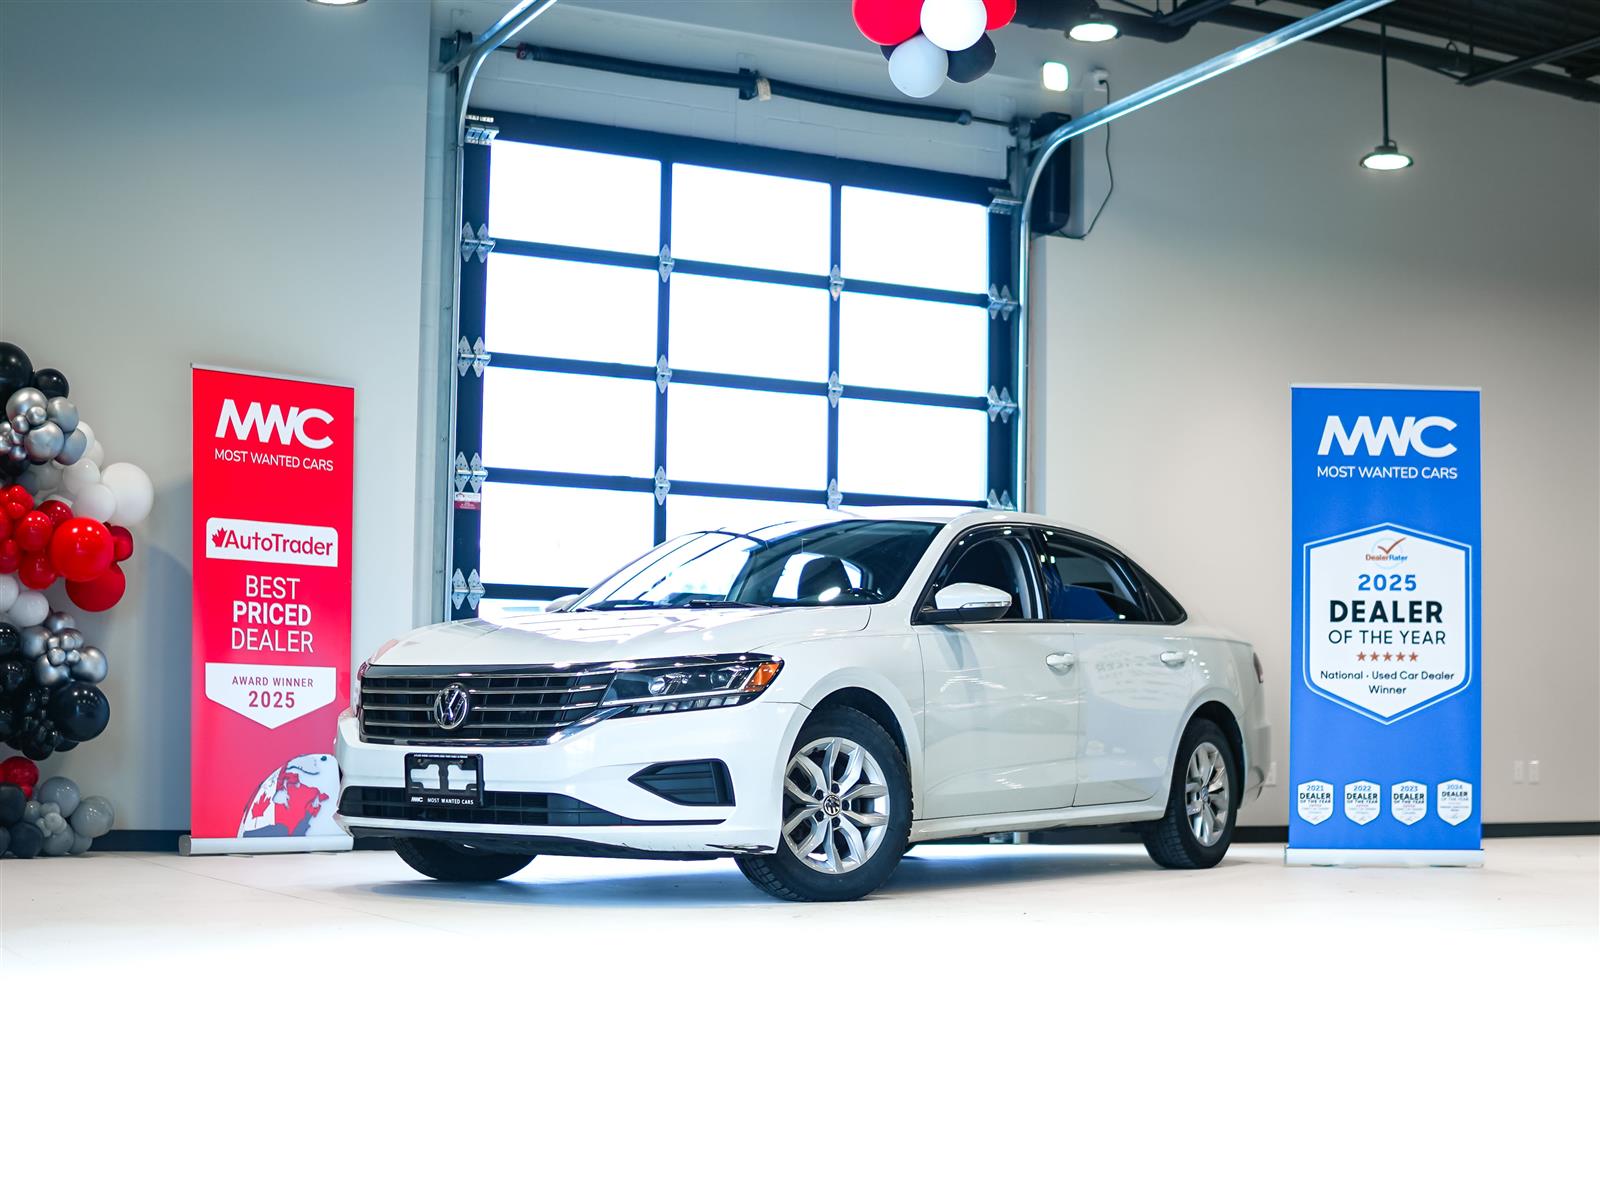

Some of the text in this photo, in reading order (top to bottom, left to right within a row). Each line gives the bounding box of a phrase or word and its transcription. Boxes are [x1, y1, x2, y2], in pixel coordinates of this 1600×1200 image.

[215, 448, 334, 471] MOST WANTED CARS
[1317, 466, 1457, 479] MOST WANTED CARS
[224, 529, 333, 556] AutoTrader
[246, 574, 300, 599] BEST
[1358, 574, 1417, 591] 2025
[233, 600, 312, 626] PRICED
[1329, 600, 1443, 623] DEALER
[231, 627, 313, 653] DEALER
[1328, 629, 1446, 645] OF THE YEAR
[232, 676, 314, 688] AWARD WINNER
[1320, 670, 1454, 680] National Used Car Dealer
[1368, 685, 1407, 694] Winner
[248, 690, 295, 709] 2025
